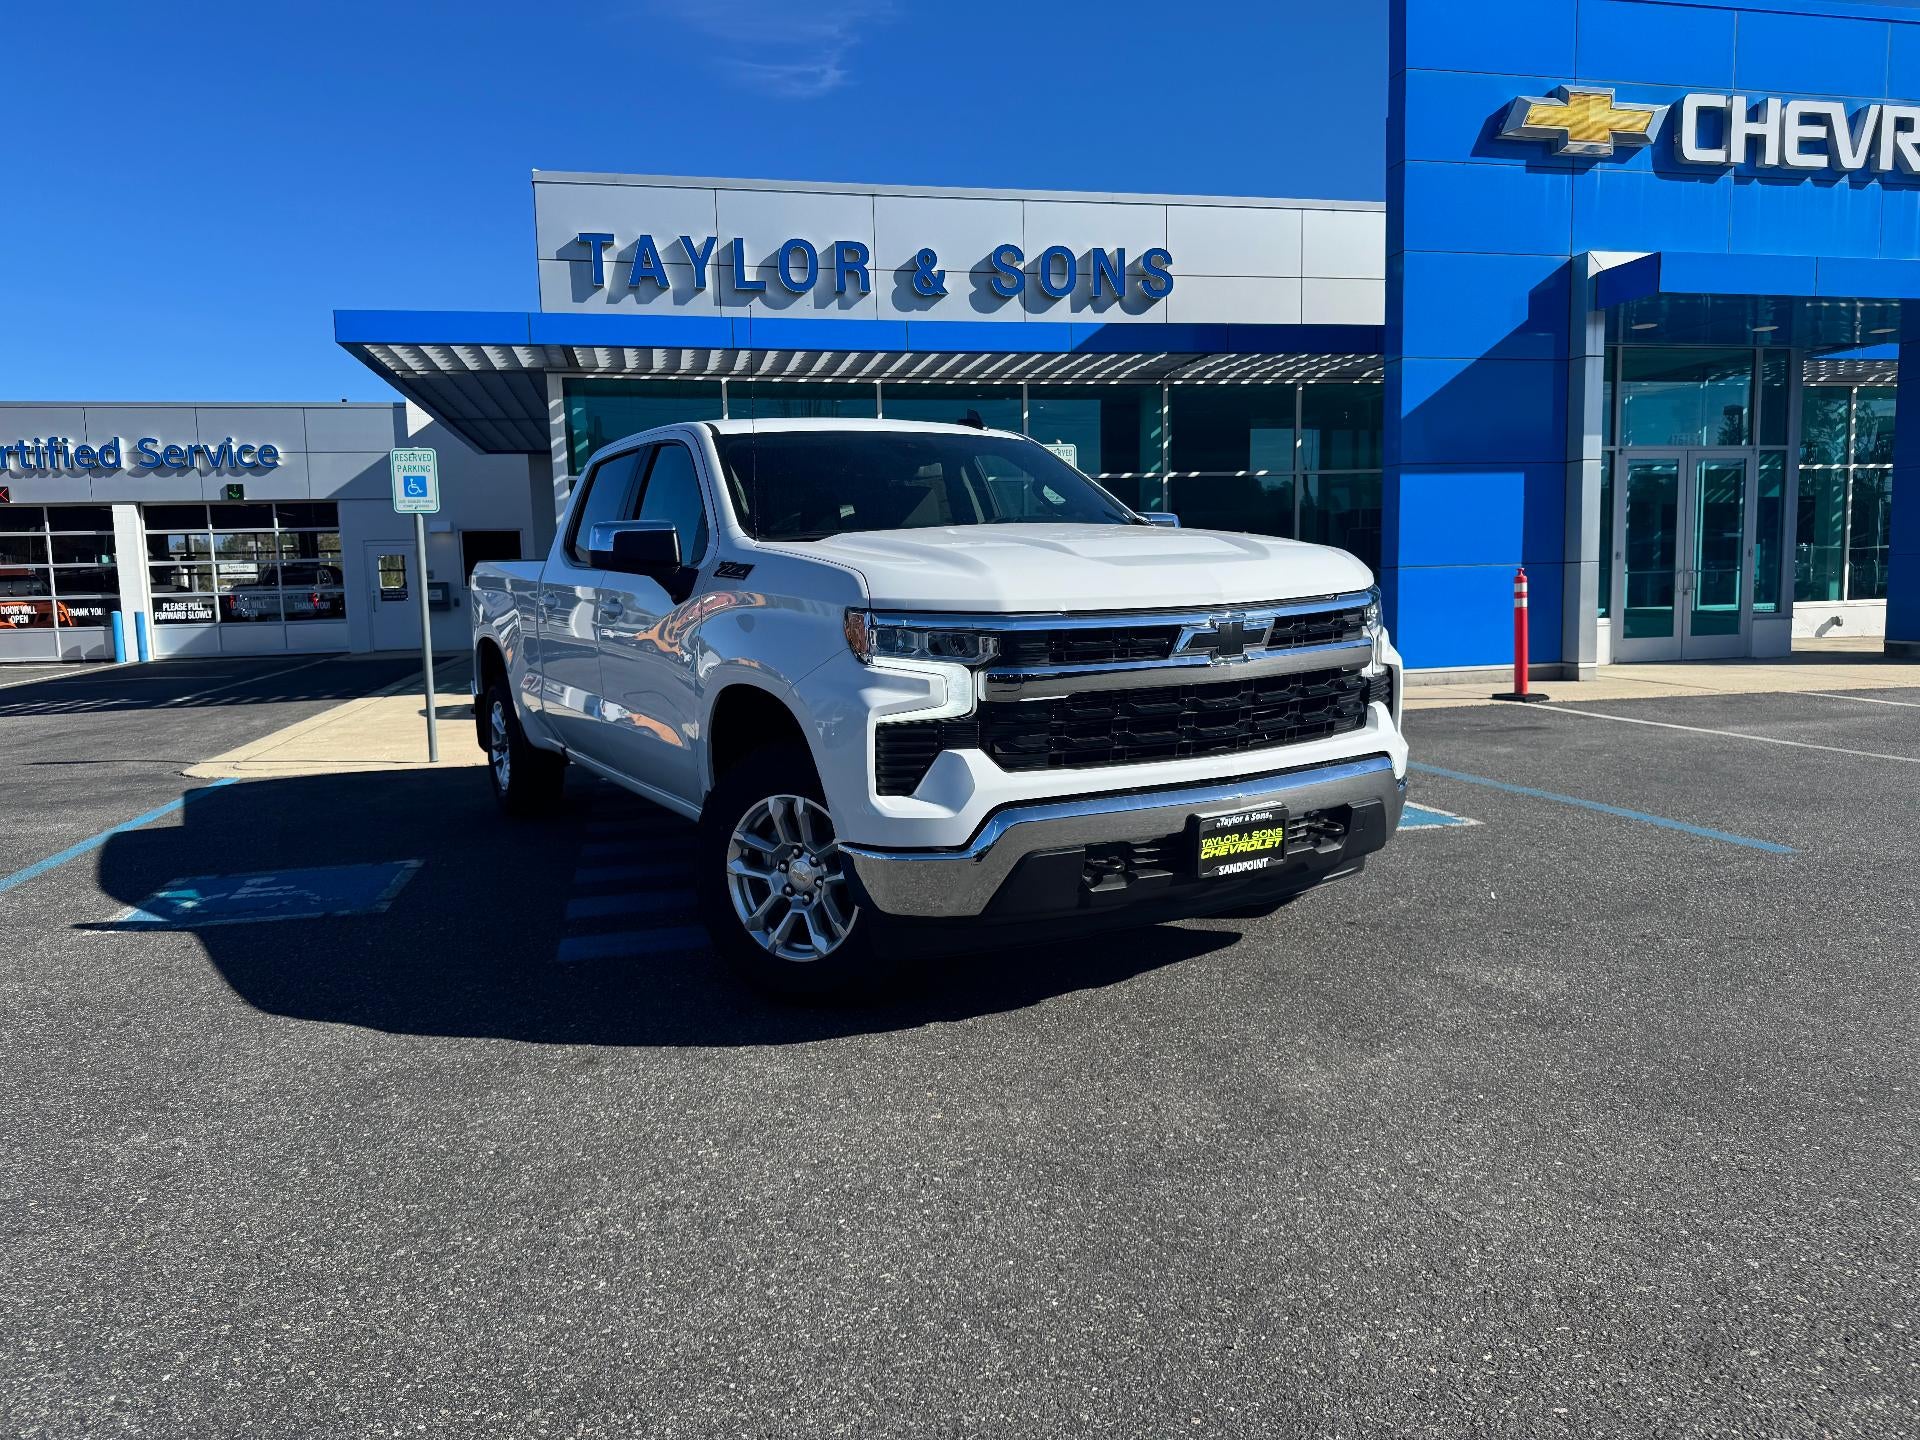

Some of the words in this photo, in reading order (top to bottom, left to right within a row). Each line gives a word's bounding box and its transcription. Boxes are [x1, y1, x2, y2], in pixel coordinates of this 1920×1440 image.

[1681, 93, 1920, 172] CHEVR
[578, 232, 871, 295] TAYLOR
[912, 248, 948, 297] &
[991, 243, 1174, 300] SONS
[0, 436, 121, 470] rtified
[137, 436, 279, 469] Service
[394, 453, 432, 462] RESERVED
[397, 464, 431, 473] PARKING
[0, 605, 20, 615] DOOR
[20, 605, 38, 614] WILL
[67, 607, 89, 617] THANK
[162, 602, 187, 611] PLEASE
[188, 602, 204, 611] PULL
[10, 614, 29, 624] OPEN
[154, 611, 187, 620] FORWARD
[188, 610, 212, 620] SLOWLY
[1219, 815, 1243, 827] Taylor
[1244, 814, 1250, 822] &
[1251, 812, 1270, 821] Sons
[1201, 833, 1240, 848] TAYLOR
[1241, 832, 1249, 842] &
[1252, 827, 1283, 840] SONS
[1200, 838, 1284, 860] CHEVROLET
[1218, 857, 1269, 876] SANDPOINT
